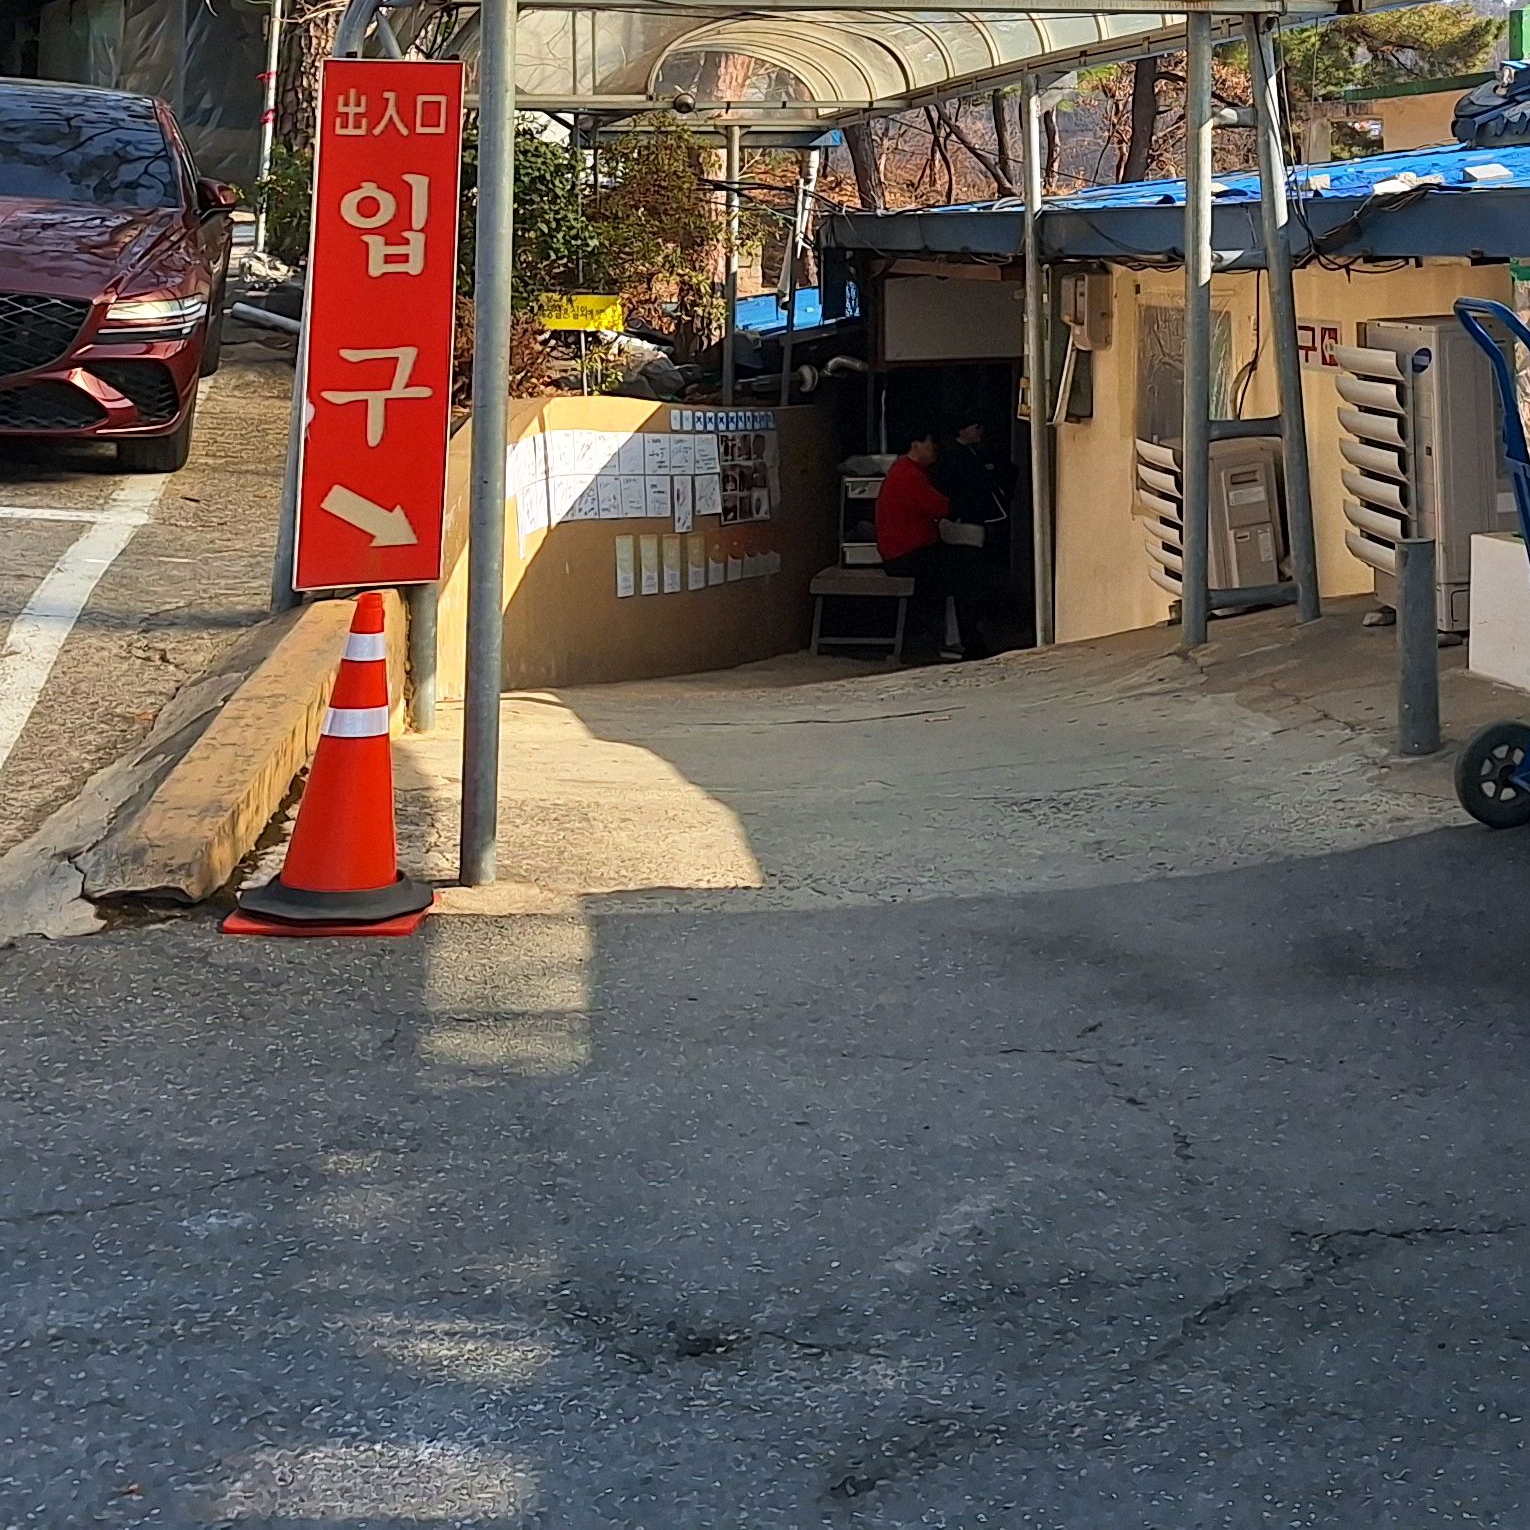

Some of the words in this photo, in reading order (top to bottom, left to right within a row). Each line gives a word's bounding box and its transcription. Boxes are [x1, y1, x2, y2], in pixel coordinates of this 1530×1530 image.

[335, 87, 448, 137] 出入口
[320, 173, 433, 449] 입구
